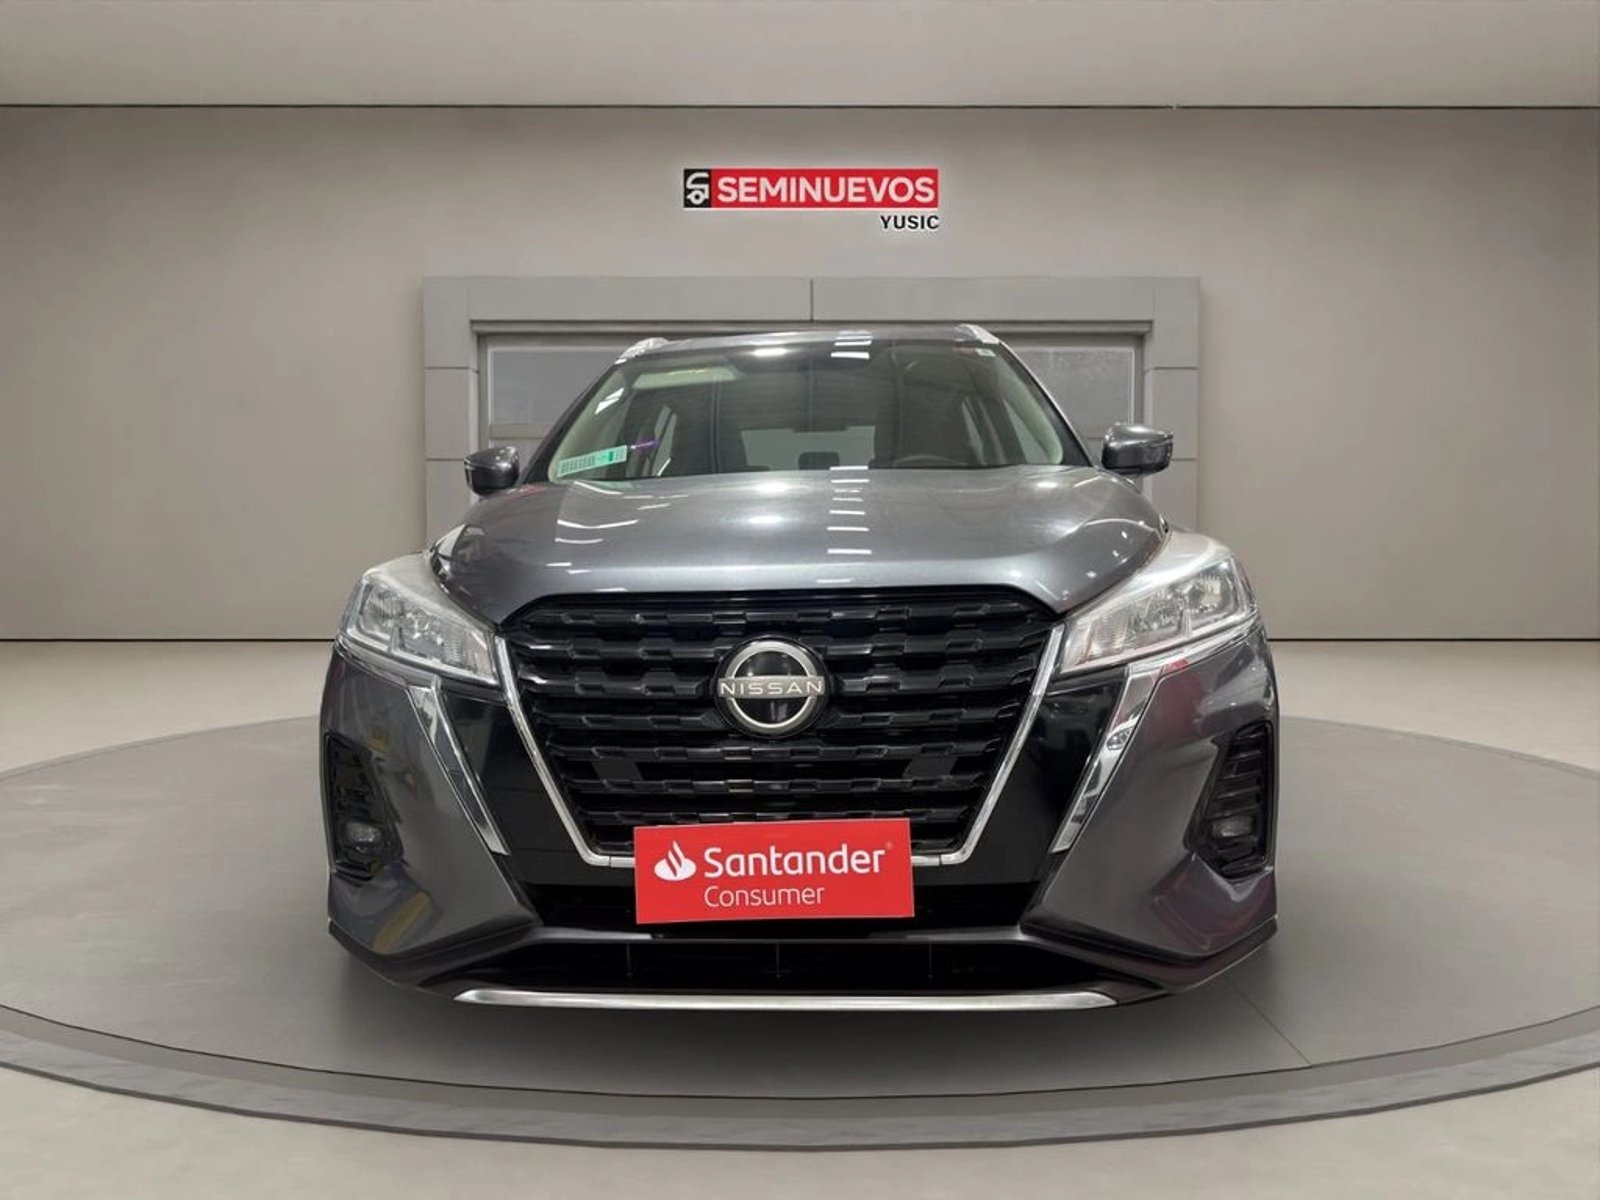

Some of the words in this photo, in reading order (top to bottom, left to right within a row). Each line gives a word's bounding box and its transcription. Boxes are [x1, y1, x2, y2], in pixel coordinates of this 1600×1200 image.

[717, 176, 936, 204] SEMINUEVOS
[880, 215, 940, 230] YUSIC
[720, 680, 822, 696] NISSAN
[703, 843, 886, 879] Santander
[703, 884, 826, 908] Consumer
